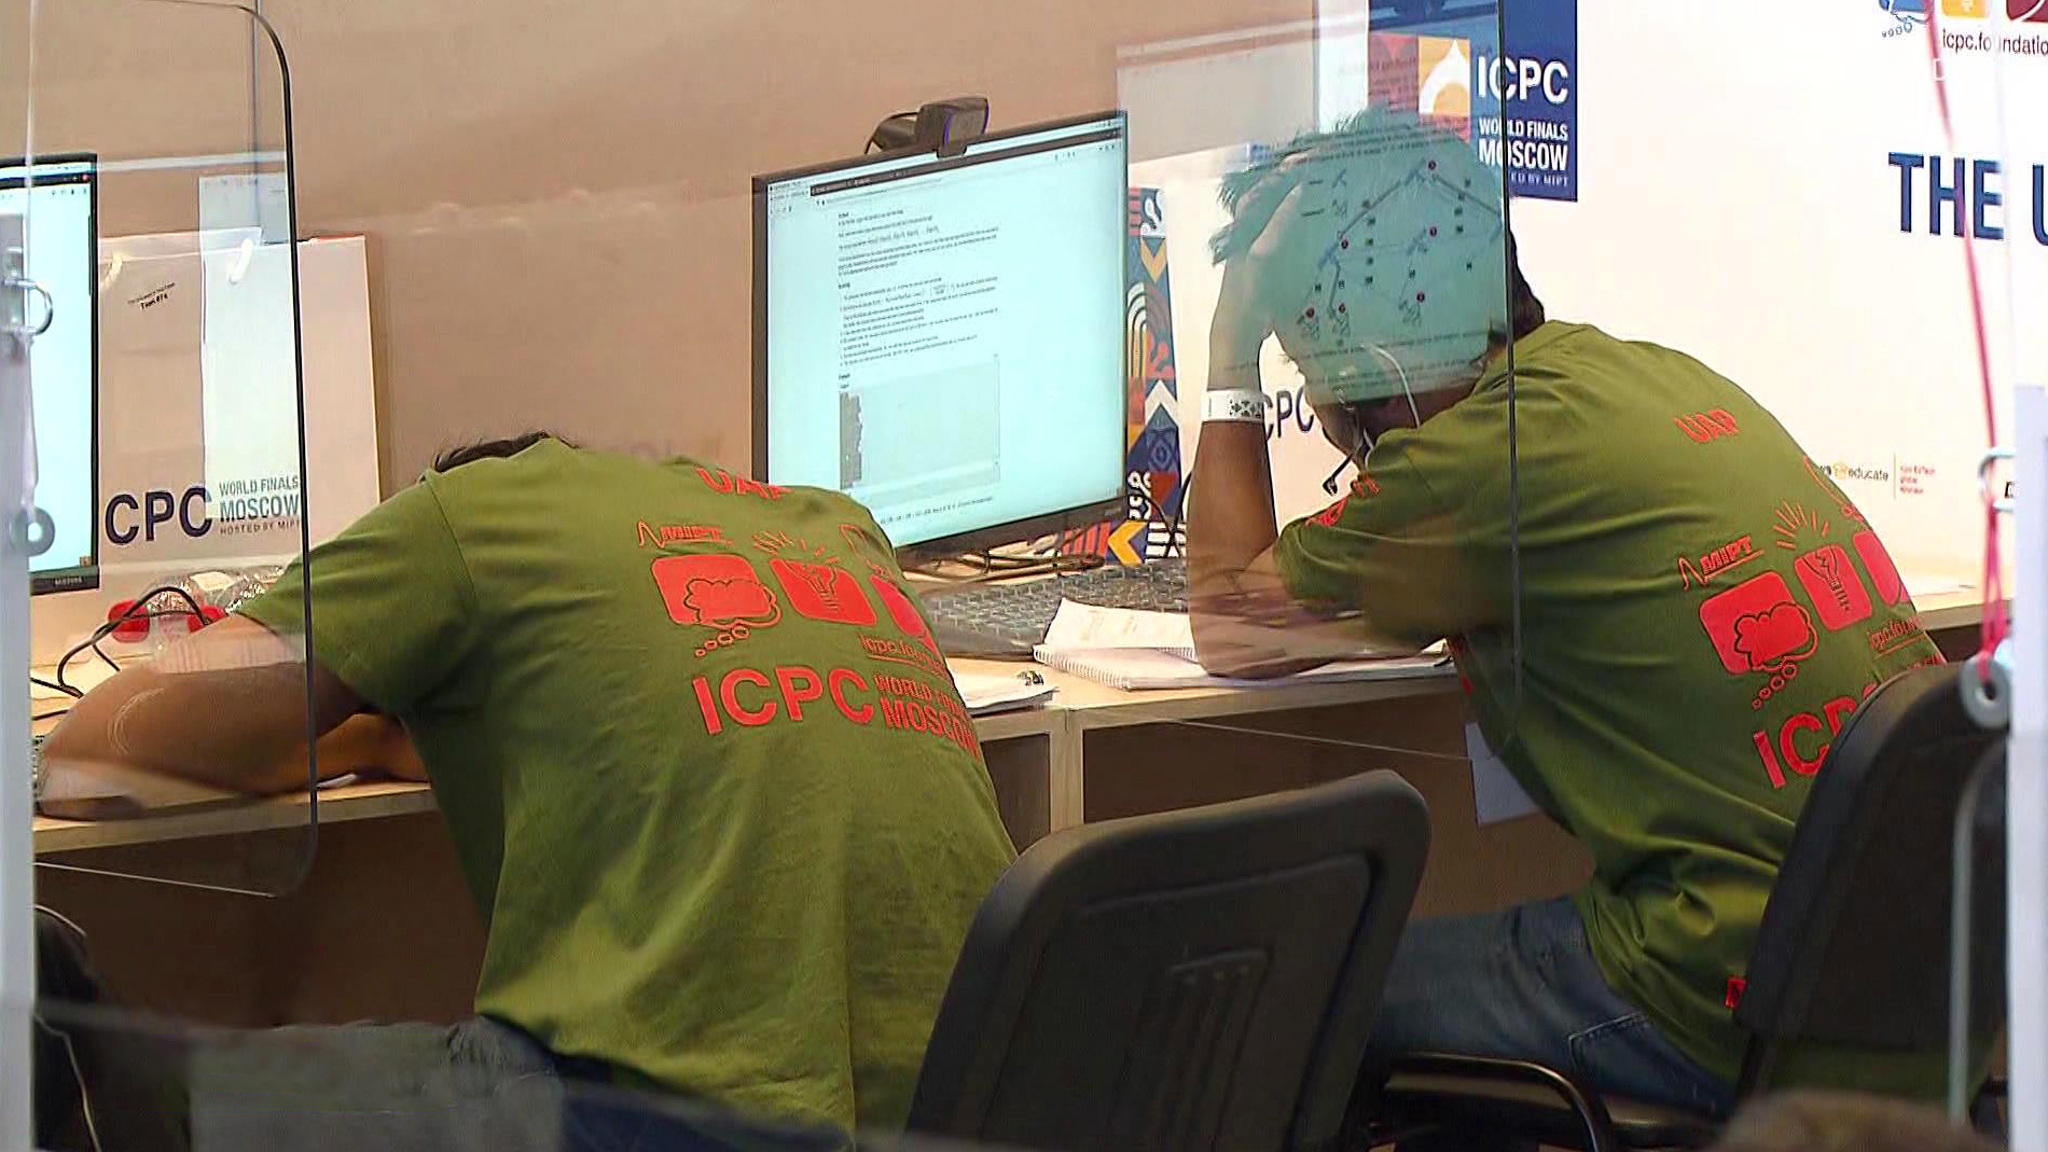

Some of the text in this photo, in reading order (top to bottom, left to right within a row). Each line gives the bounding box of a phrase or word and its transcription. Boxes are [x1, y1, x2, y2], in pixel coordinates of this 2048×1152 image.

[1943, 29, 2048, 55] icpc.fondatio
[1477, 56, 1569, 105] ICPC
[1526, 120, 1569, 141] FINALS
[1478, 138, 1569, 171] MOSCOW
[1888, 152, 2004, 241] THE
[219, 475, 299, 497] WORLD FINALS
[105, 485, 213, 544] CPC
[220, 494, 300, 523] MOSCOW
[692, 665, 873, 736] ICPC
[1753, 682, 1878, 789] ICP
